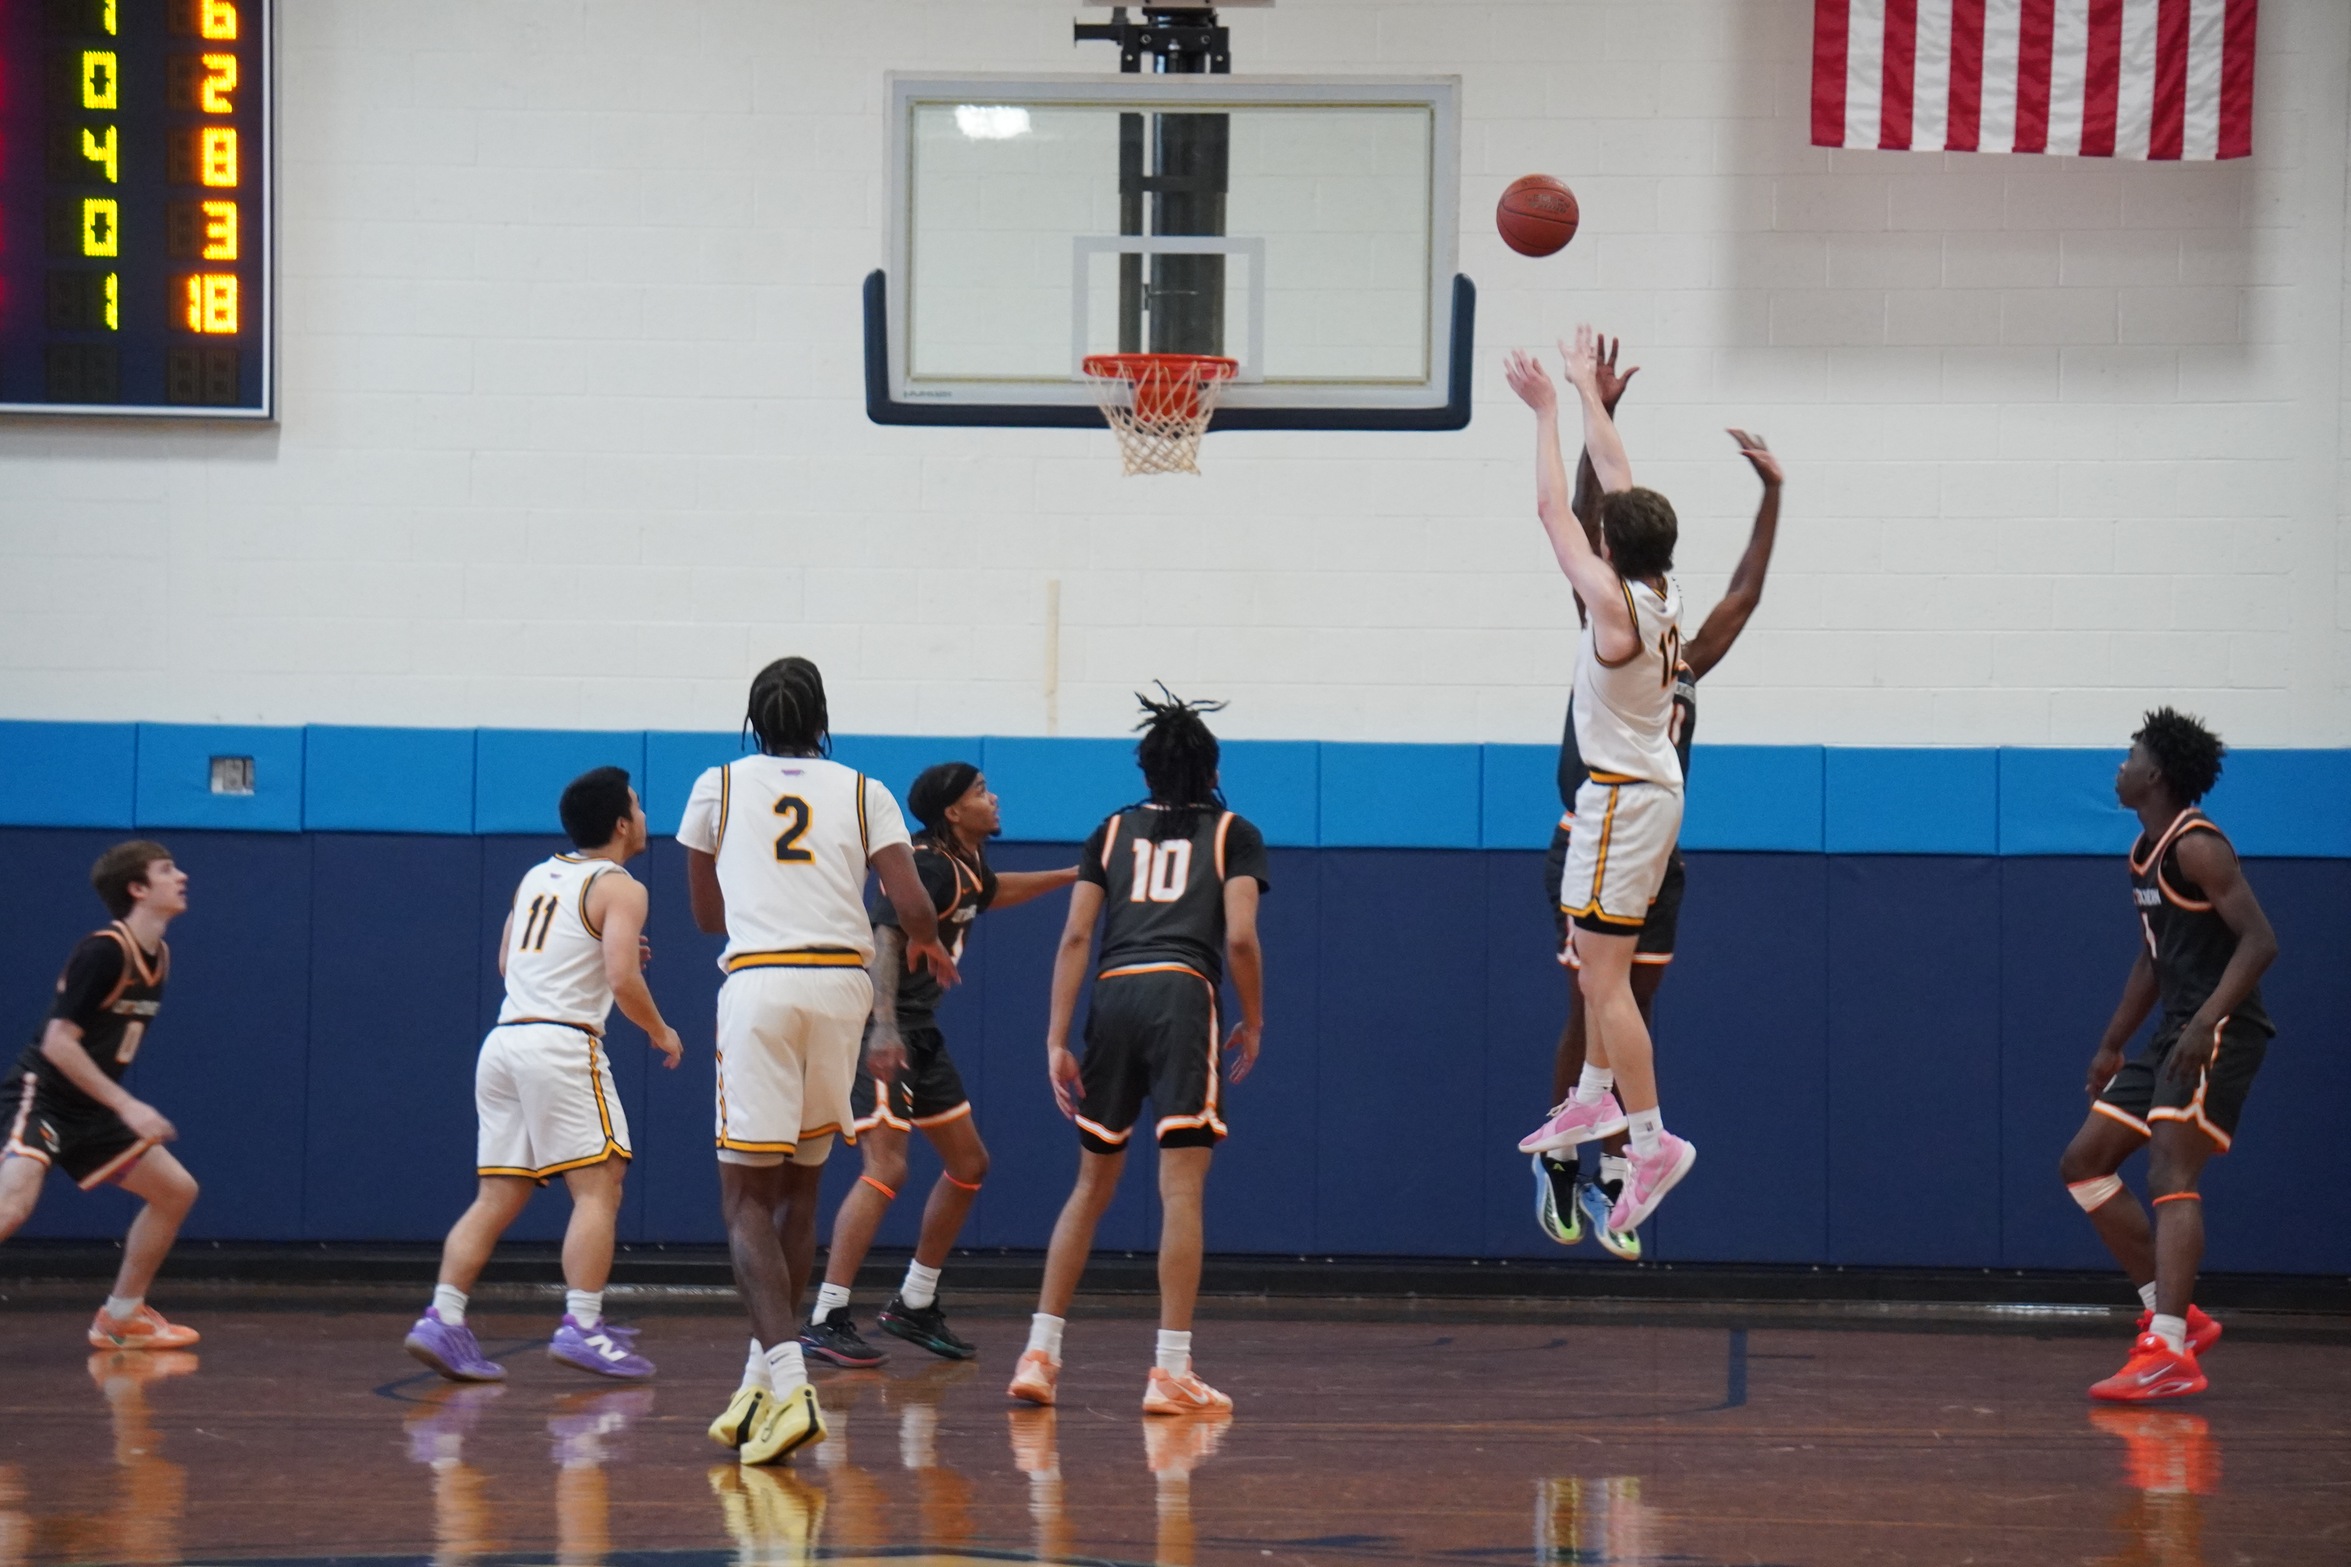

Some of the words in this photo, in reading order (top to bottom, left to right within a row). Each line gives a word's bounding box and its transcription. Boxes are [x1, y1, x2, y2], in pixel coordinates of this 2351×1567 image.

[83, 51, 117, 109] 0
[202, 53, 237, 113] 2
[83, 125, 117, 183] 4
[202, 127, 237, 187] 8
[83, 199, 117, 257] 0
[202, 201, 237, 260] 3
[105, 272, 118, 331] 1
[187, 274, 238, 334] 18
[1659, 624, 1680, 688] 12
[773, 794, 816, 865] 2
[1130, 837, 1193, 903] 10
[519, 892, 560, 953] 11
